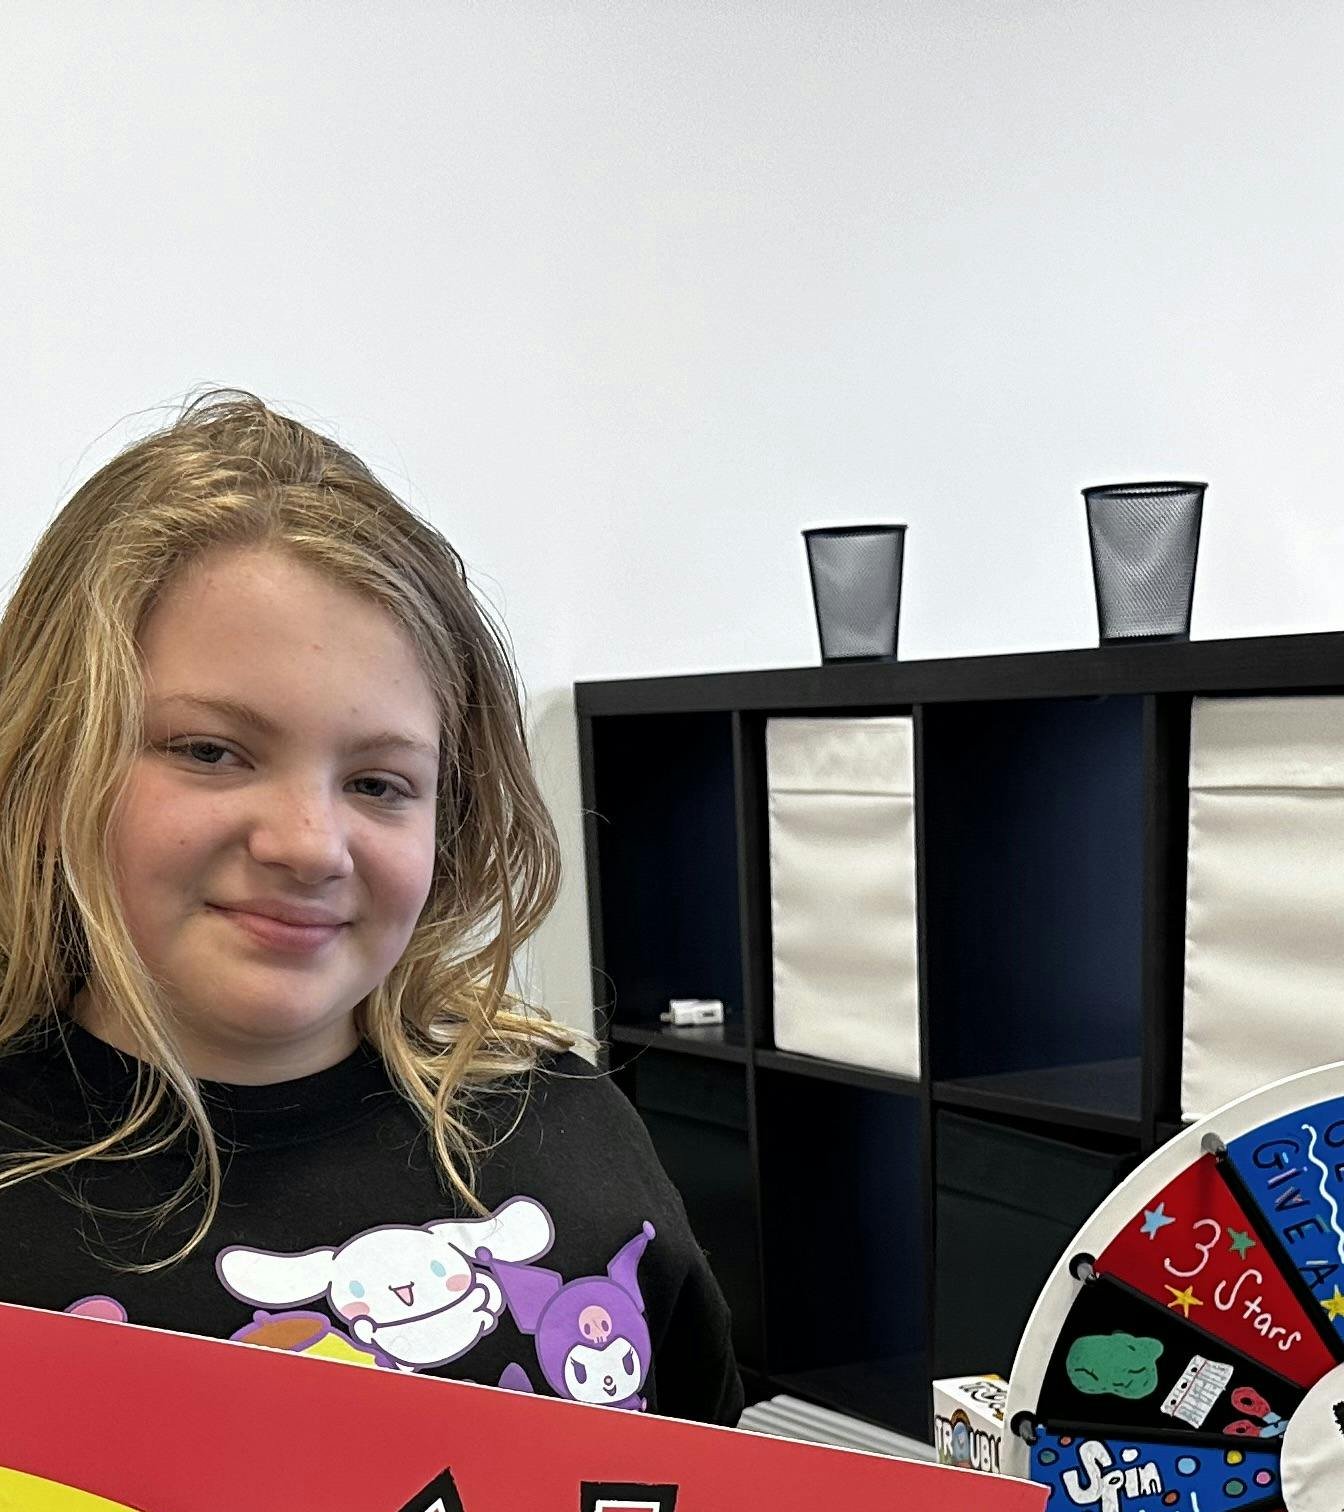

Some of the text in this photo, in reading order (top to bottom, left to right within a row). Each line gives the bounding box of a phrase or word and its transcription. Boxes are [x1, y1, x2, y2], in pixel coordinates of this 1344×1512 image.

[1164, 1218, 1302, 1351] 3 Stars
[1298, 1260, 1340, 1290] A
